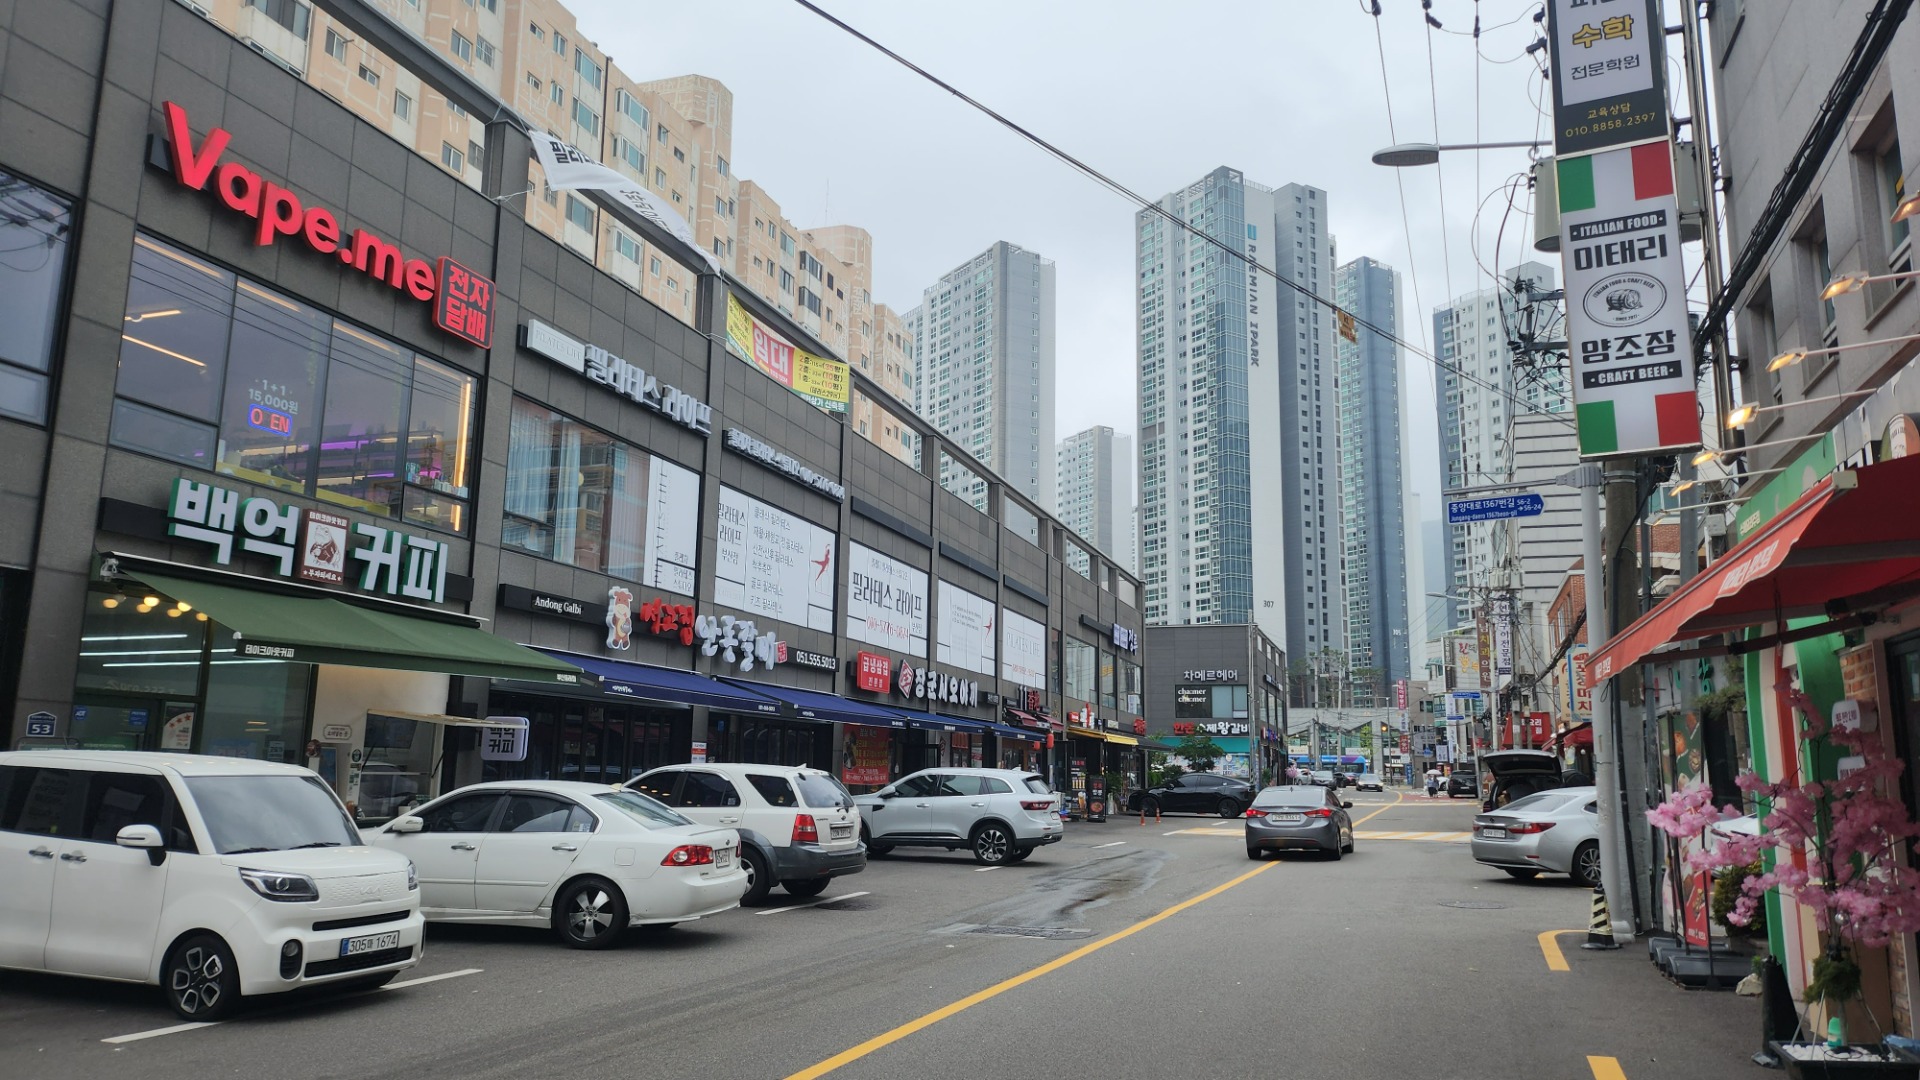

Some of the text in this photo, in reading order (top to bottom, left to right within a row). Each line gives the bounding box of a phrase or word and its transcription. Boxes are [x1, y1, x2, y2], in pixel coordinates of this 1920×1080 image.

[1572, 14, 1634, 49] 수학
[1571, 54, 1640, 81] 전문학원
[1587, 102, 1631, 119] 교육상담
[1565, 112, 1656, 138] 010.8858.2397
[162, 100, 435, 302] Vape.me
[1580, 213, 1659, 237] ITALIAN FOOD
[449, 265, 490, 311] 전자
[445, 296, 487, 342] 담배
[754, 327, 789, 376] 임대
[1250, 321, 1259, 367] IPARK
[1597, 365, 1669, 385] CRAFT BEER
[248, 389, 298, 415] 15,000원
[585, 343, 712, 435] 필라테스 라이프
[1451, 498, 1515, 513] 중앙대로1367번길
[170, 478, 449, 604] 백억 커피
[720, 524, 742, 546] 라이프
[535, 596, 582, 615] Andong Galbi
[853, 571, 893, 610] 필라테스
[896, 588, 922, 620] 라이프
[244, 644, 295, 658] 테이크아웃커피
[695, 615, 776, 672] 안동갈비
[796, 650, 836, 670] 051.555.5013
[1183, 669, 1238, 682] 차메르헤어
[31, 724, 50, 734] 53
[488, 739, 514, 753] 커피
[376, 934, 397, 948] 1674
